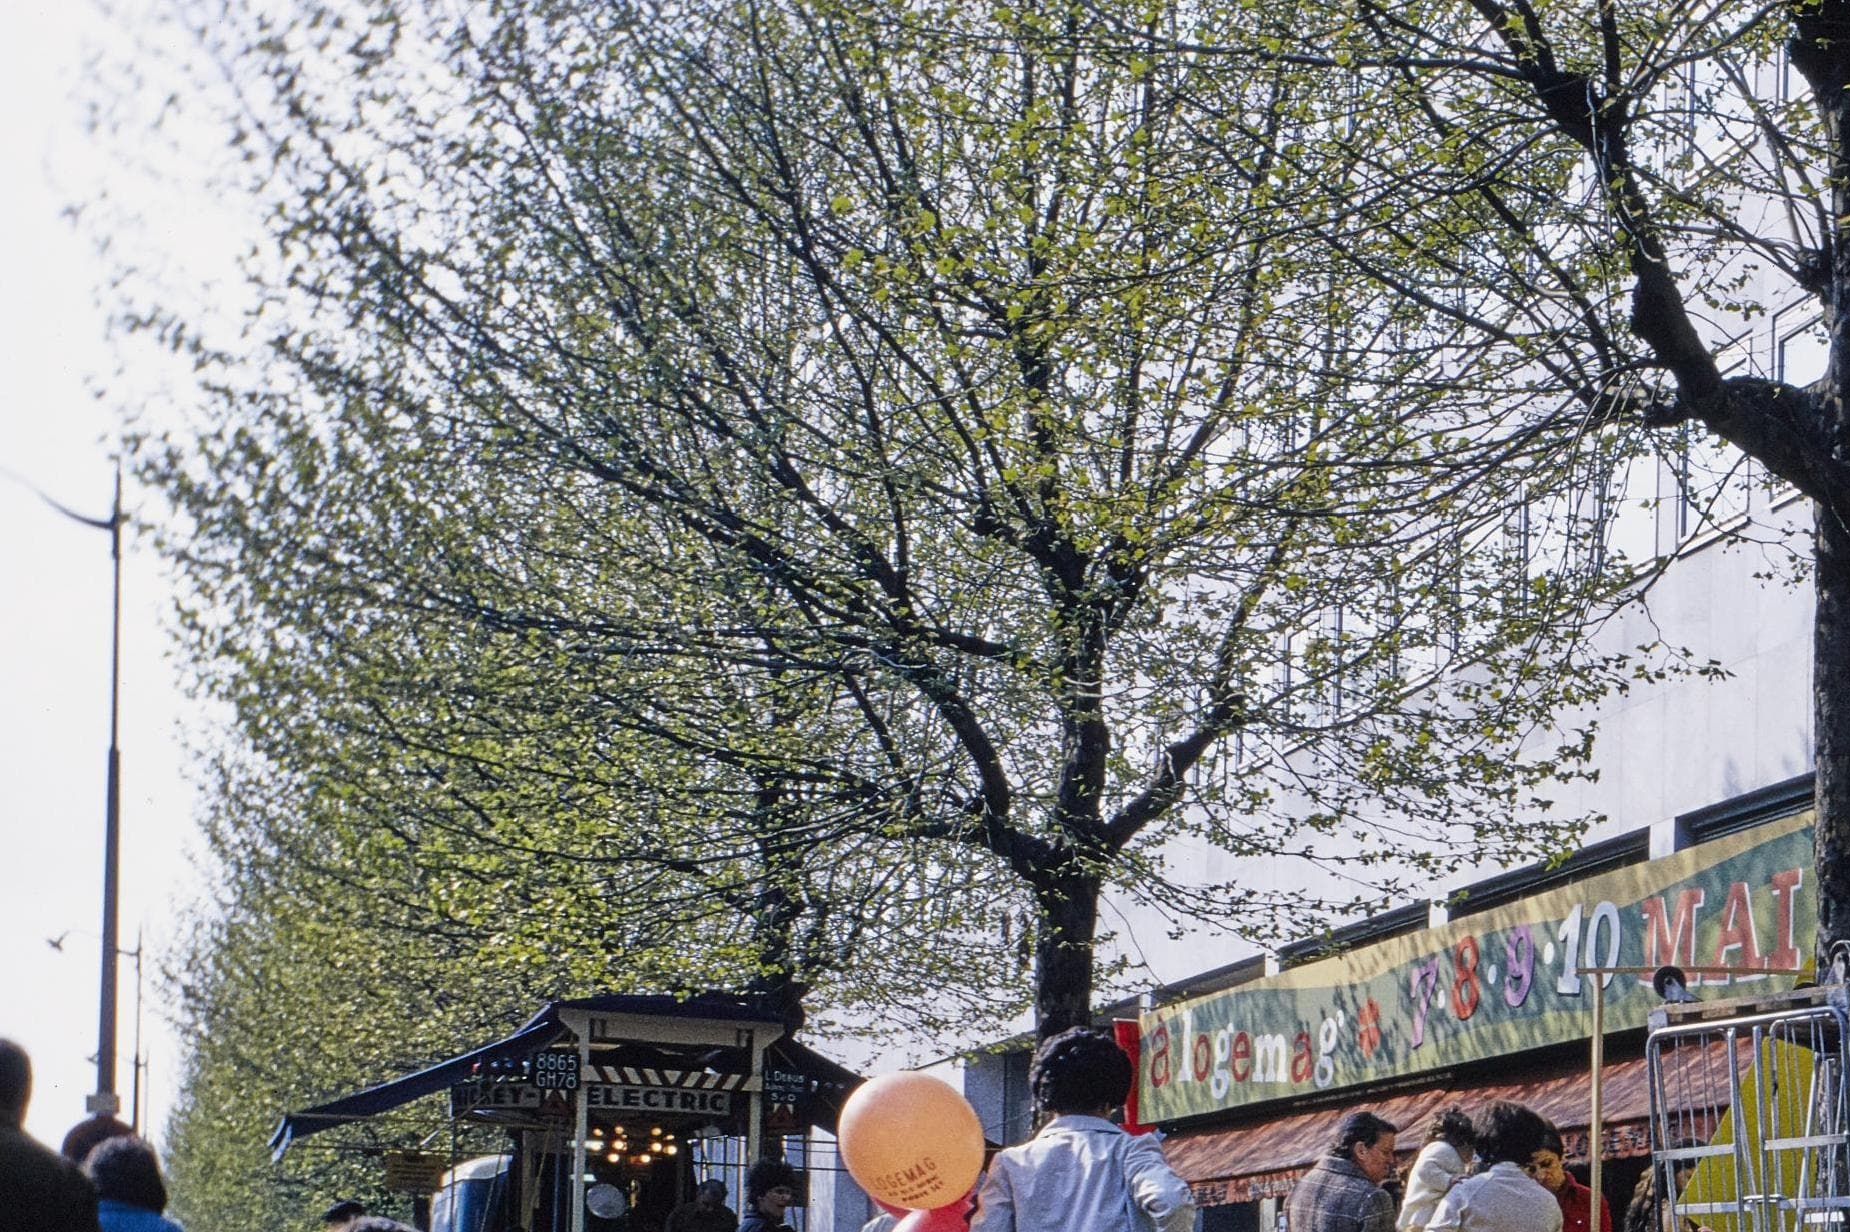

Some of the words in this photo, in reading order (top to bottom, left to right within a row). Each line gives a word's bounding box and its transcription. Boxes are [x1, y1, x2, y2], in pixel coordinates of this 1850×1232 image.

[1178, 1009, 1345, 1099] logemag
[1639, 868, 1803, 988] MAI
[536, 1053, 577, 1071] 8865
[587, 1086, 724, 1112] ELECTRIC
